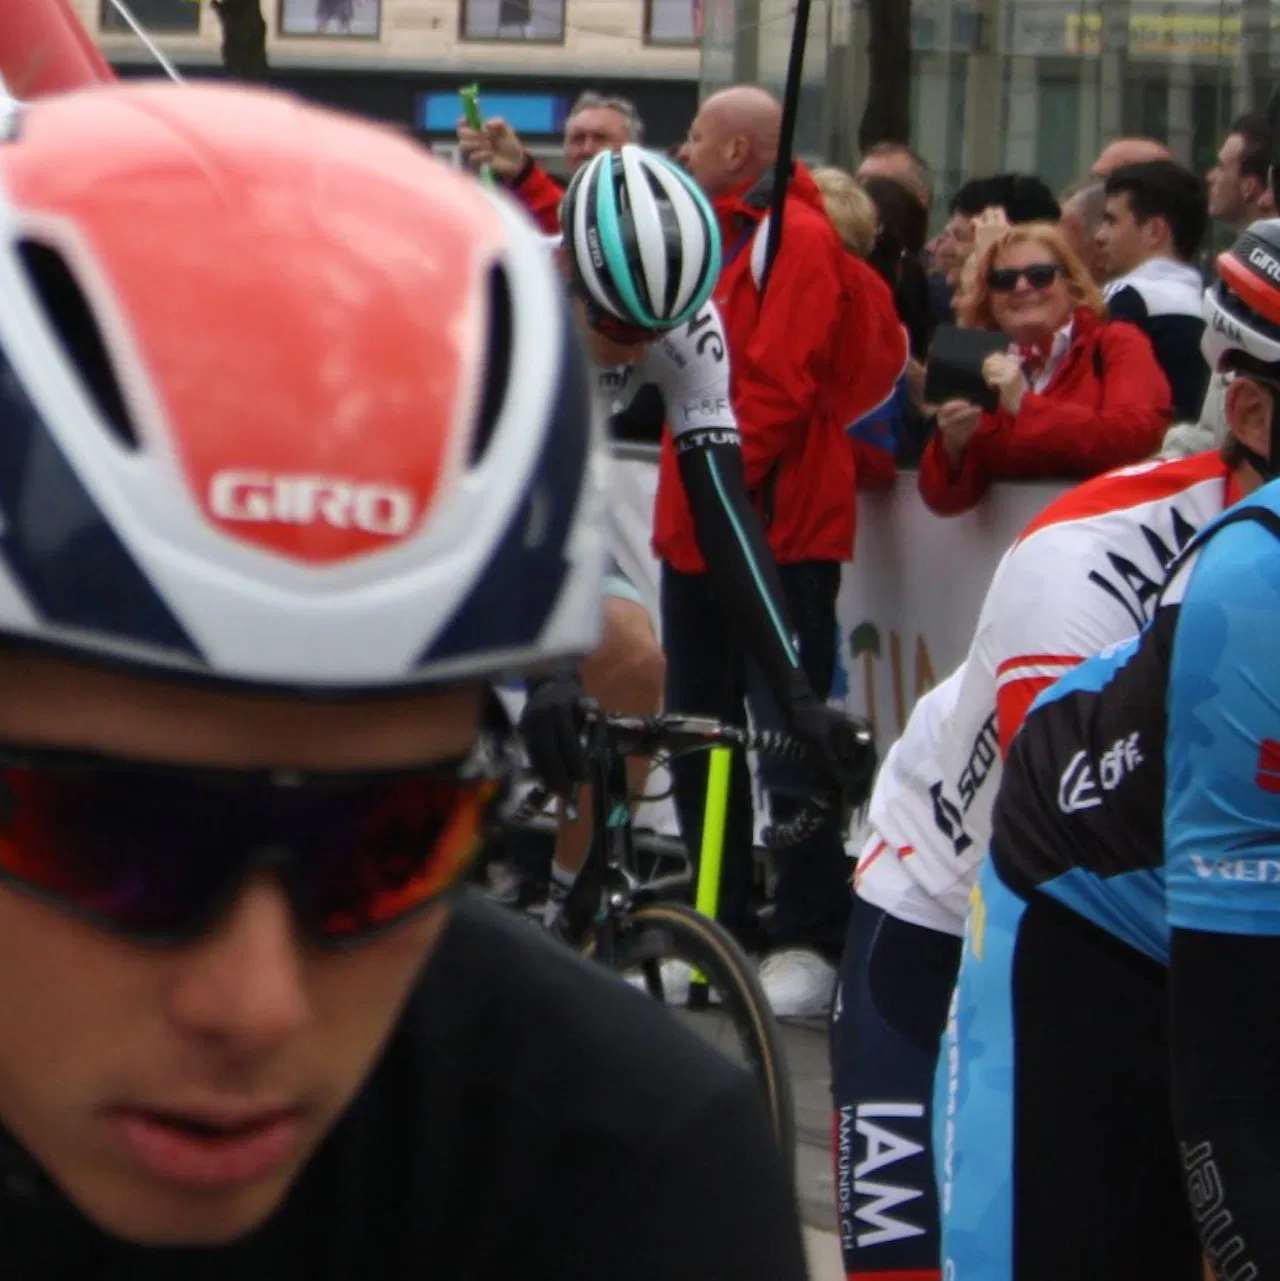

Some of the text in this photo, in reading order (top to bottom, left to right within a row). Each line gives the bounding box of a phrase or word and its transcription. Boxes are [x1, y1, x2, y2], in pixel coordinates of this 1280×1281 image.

[209, 467, 417, 539] GIRO
[957, 711, 999, 813] SCOT
[853, 1102, 927, 1249] IAM
